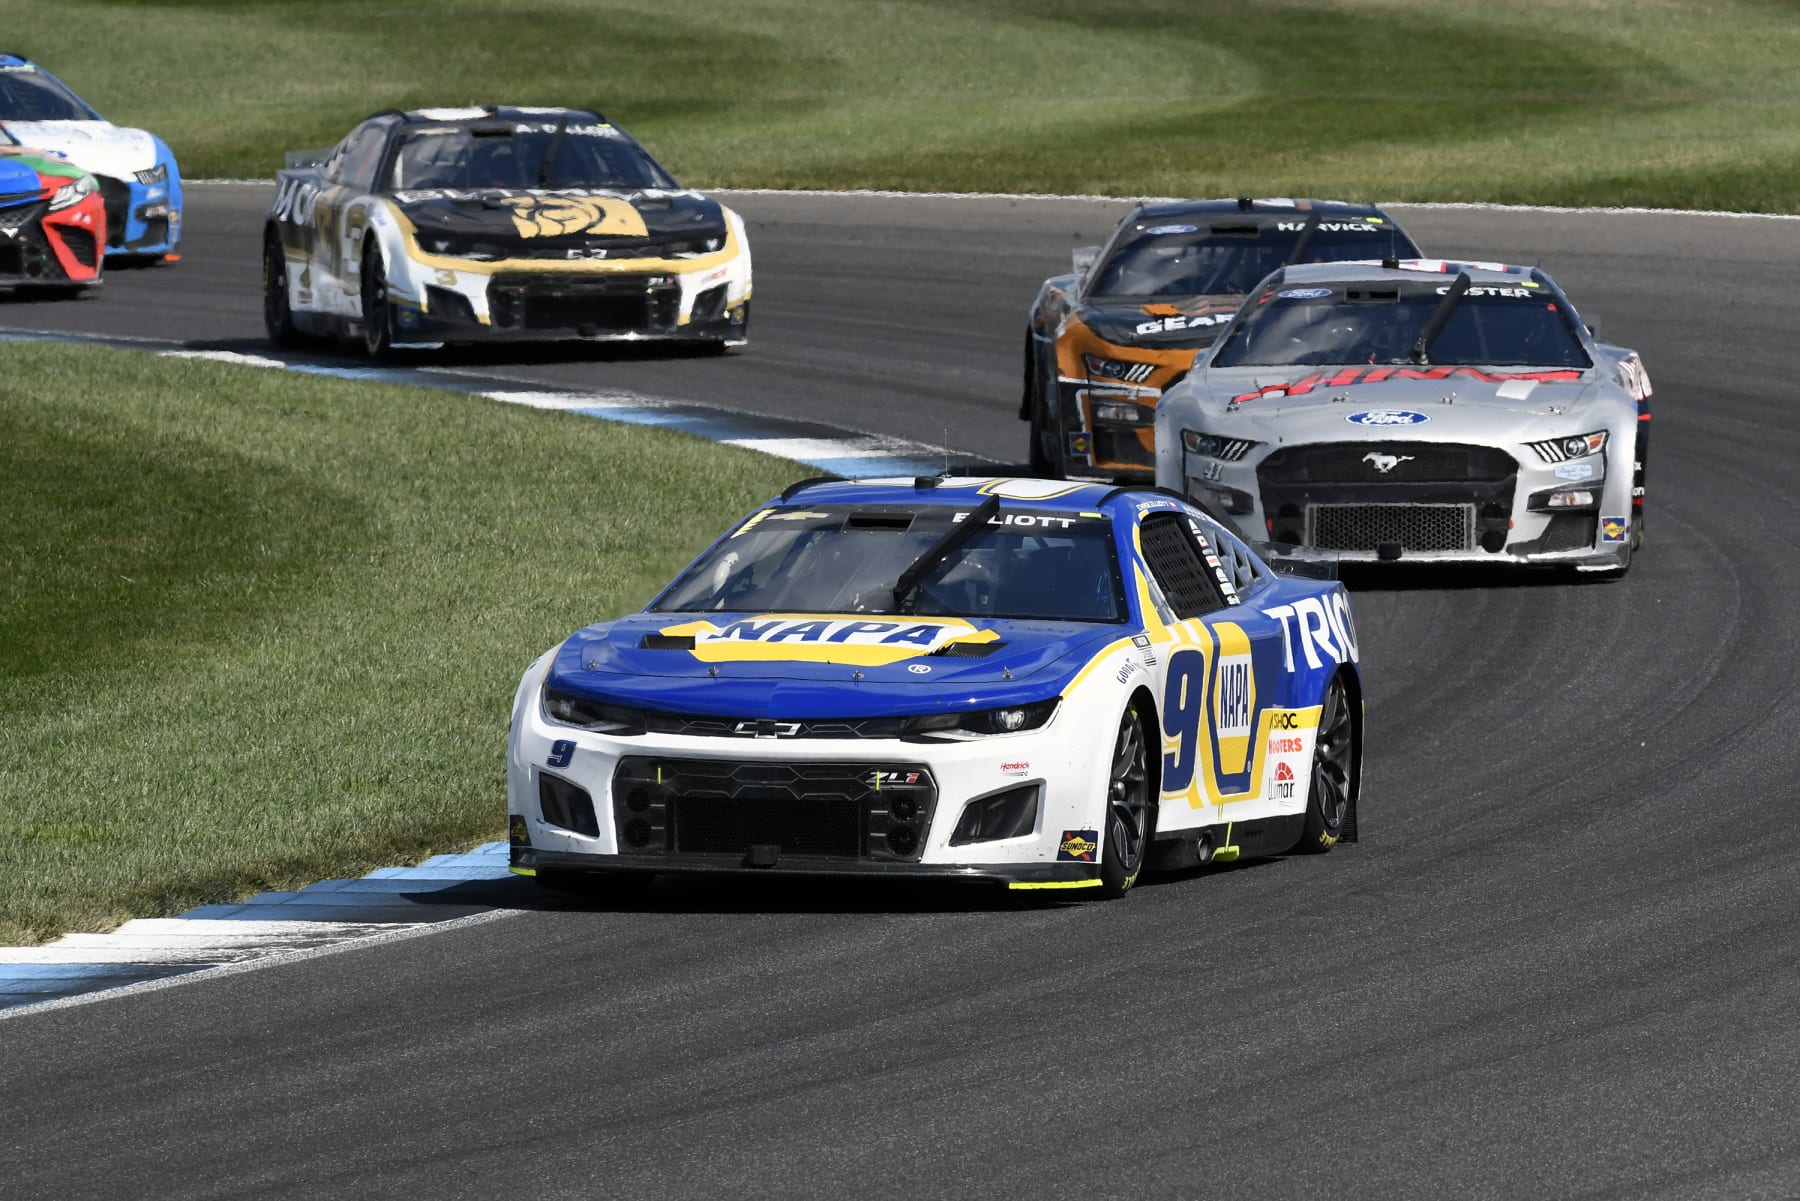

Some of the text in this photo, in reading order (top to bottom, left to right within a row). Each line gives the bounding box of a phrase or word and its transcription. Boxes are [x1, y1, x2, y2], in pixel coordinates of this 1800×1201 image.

[1360, 410, 1415, 425] Ford
[952, 512, 1077, 528] ELIOTT
[707, 621, 942, 645] NAPA
[1219, 663, 1249, 729] NAPA
[1163, 648, 1206, 794] 9
[1268, 737, 1303, 754] HOOTERS
[546, 740, 577, 769] 9
[1000, 761, 1031, 771] Hendrick
[866, 771, 920, 784] ZL1
[1060, 841, 1097, 851] SUNOCO
